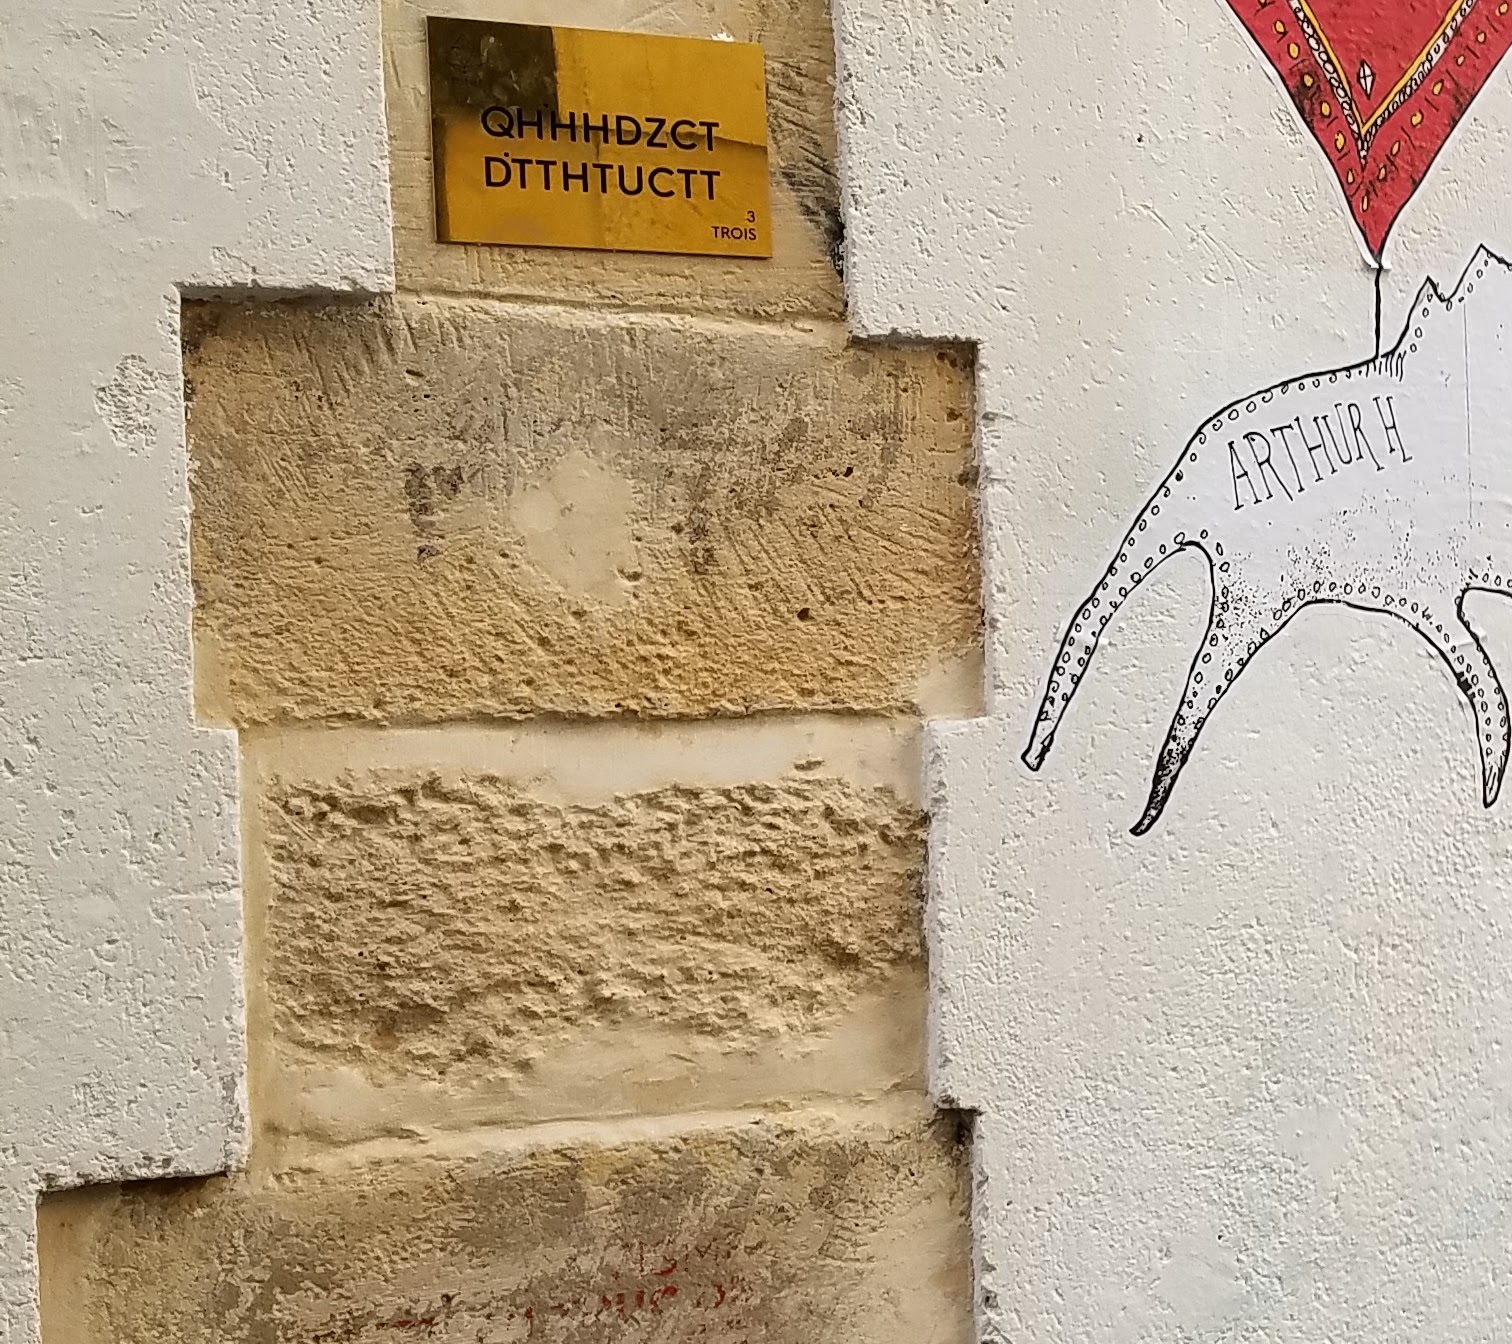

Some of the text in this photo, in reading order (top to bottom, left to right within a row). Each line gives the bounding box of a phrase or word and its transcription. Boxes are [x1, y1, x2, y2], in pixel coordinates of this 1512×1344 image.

[480, 105, 720, 152] QHHHDZCT
[746, 210, 756, 223] 3
[711, 226, 757, 241] TROIS
[1226, 395, 1413, 512] ARTHUR H
